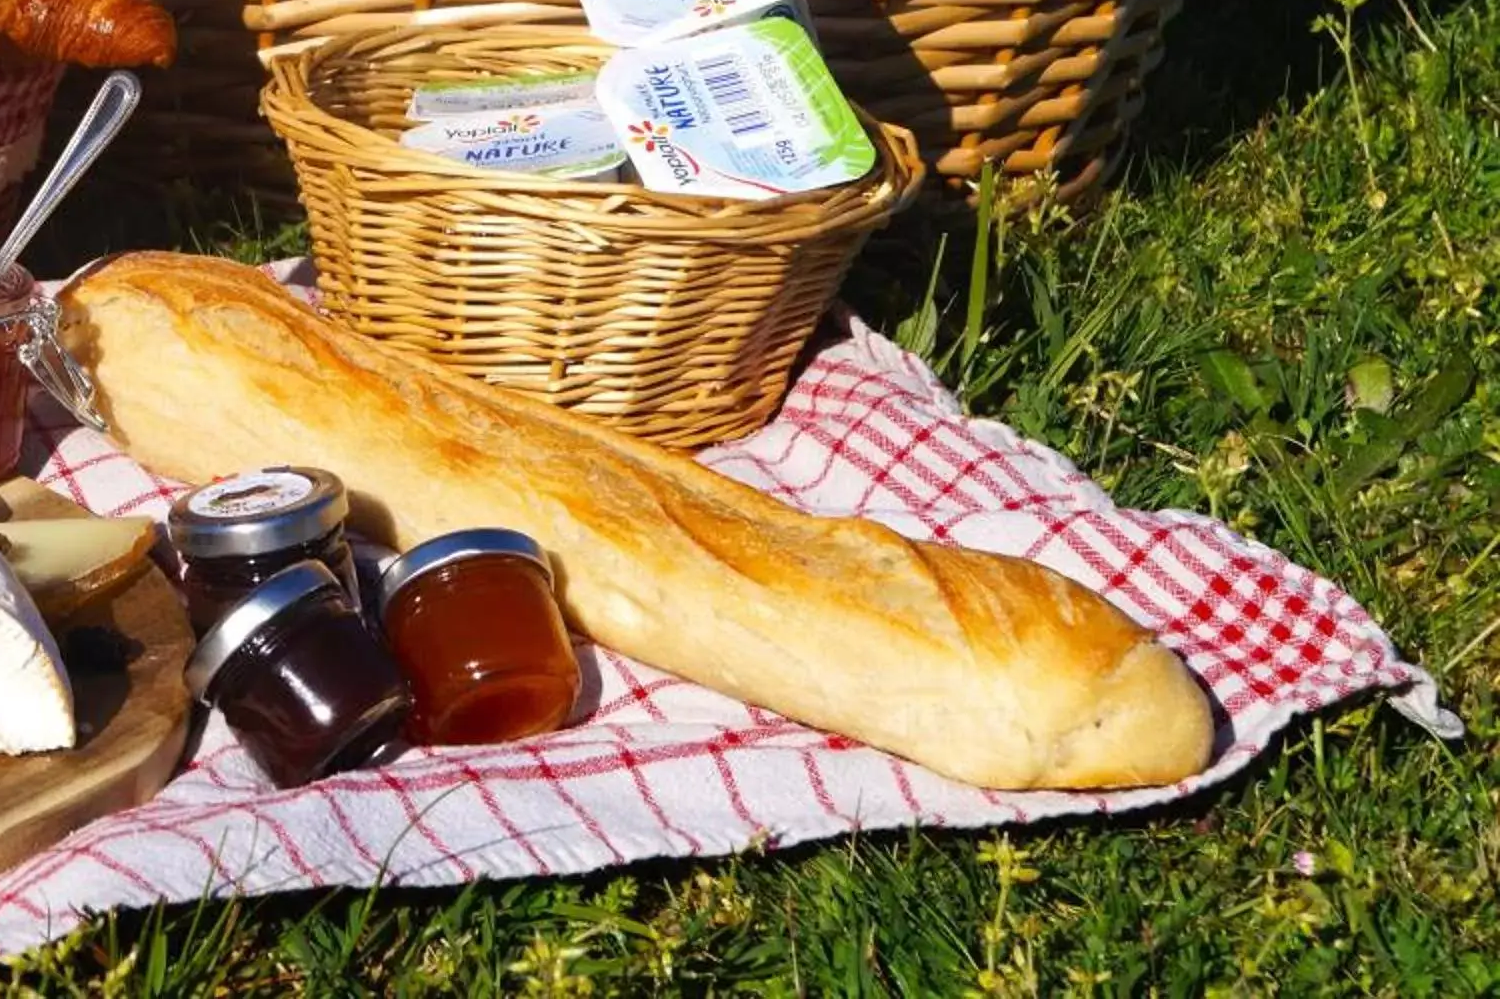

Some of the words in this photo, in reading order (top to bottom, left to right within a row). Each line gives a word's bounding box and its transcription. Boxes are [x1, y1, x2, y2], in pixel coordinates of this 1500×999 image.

[644, 63, 698, 131] NATURE
[444, 123, 519, 140] Yoplait
[465, 137, 573, 163] NATURE
[651, 134, 699, 187] Yoplait
[774, 138, 799, 167] 125g
